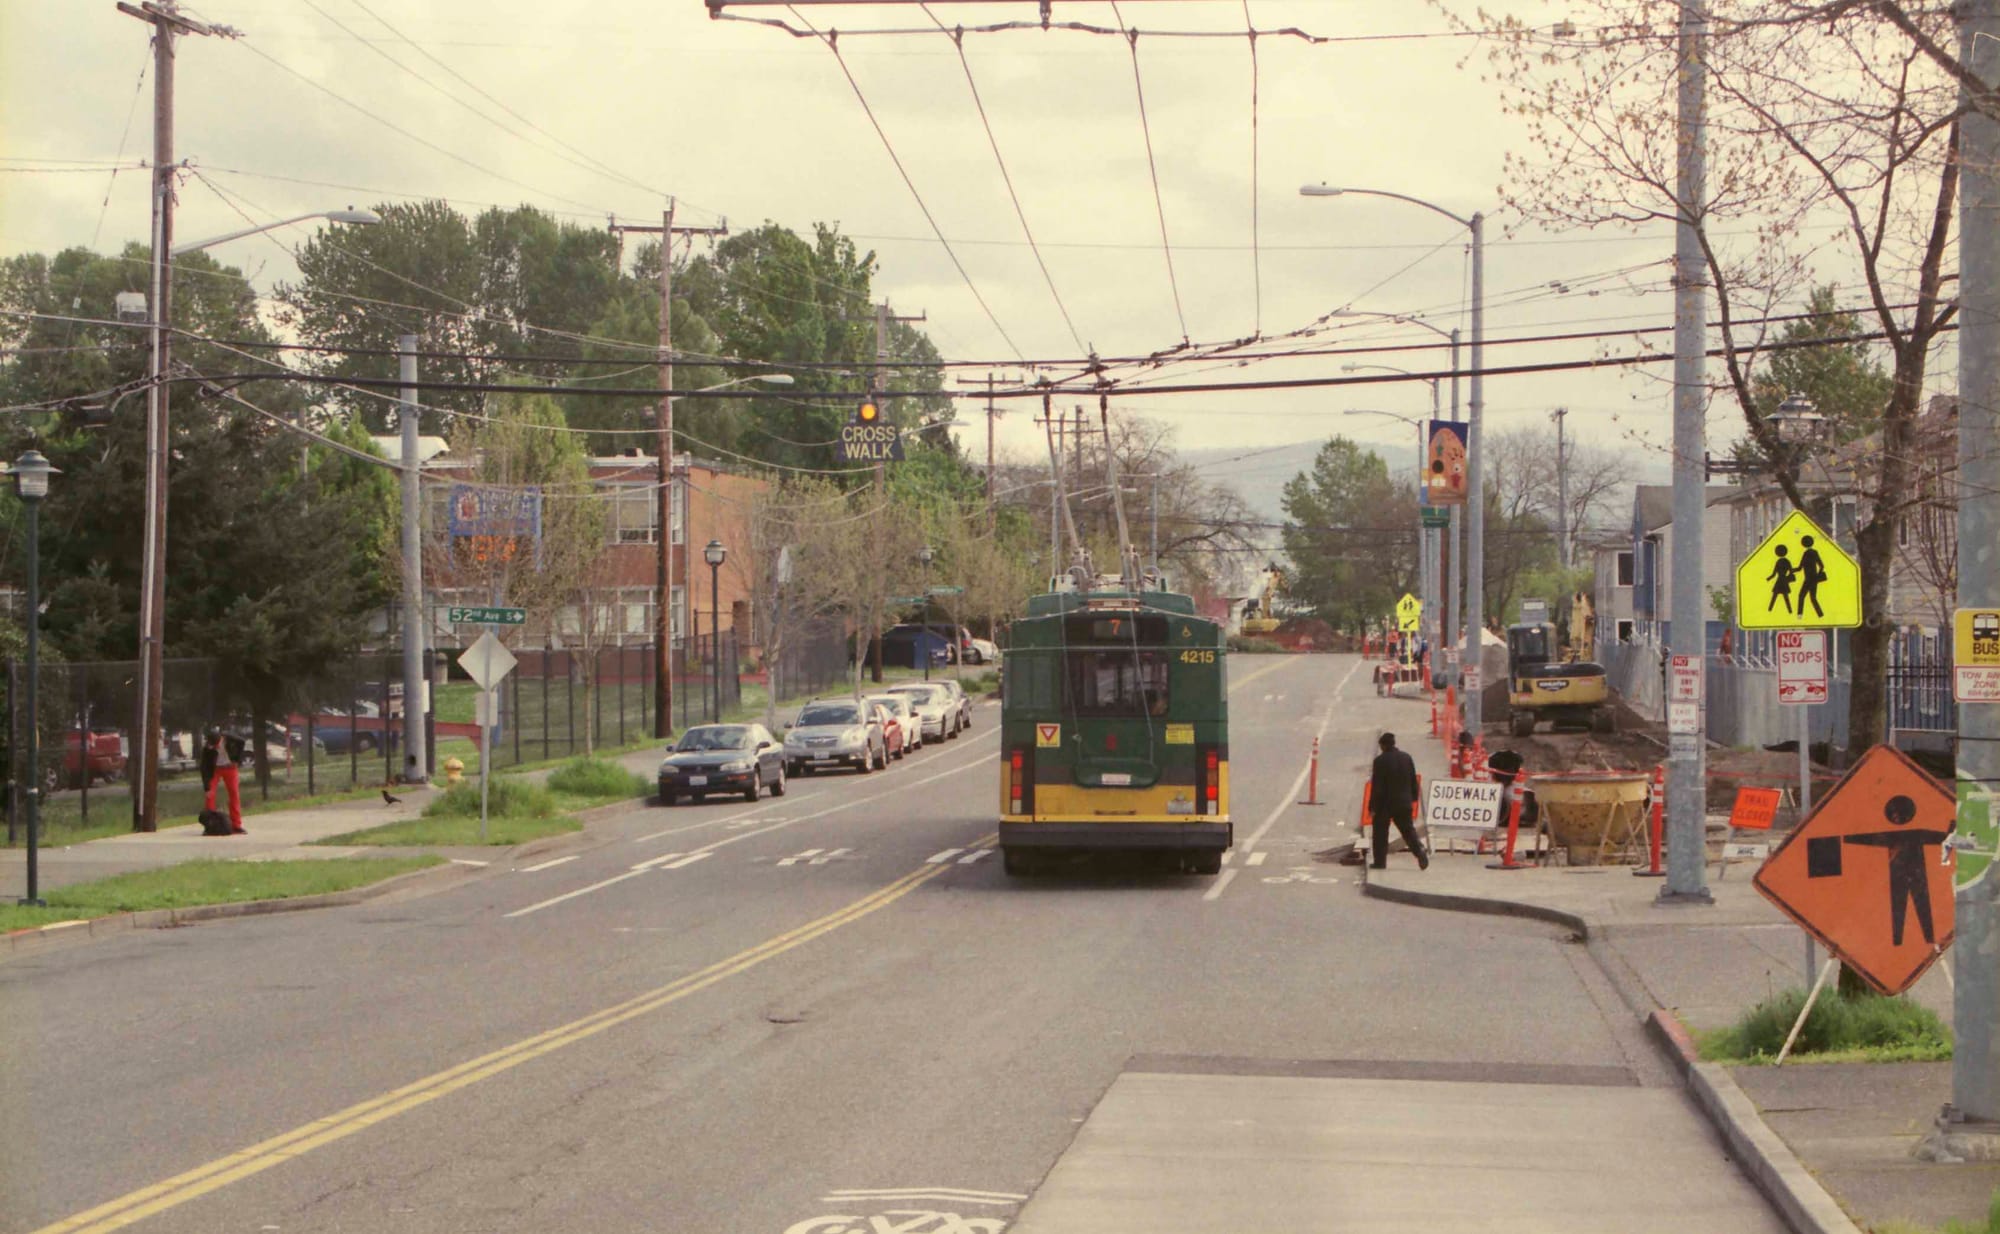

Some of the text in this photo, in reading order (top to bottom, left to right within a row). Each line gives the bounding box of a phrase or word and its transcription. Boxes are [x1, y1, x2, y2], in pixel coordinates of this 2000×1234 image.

[842, 426, 896, 442] CROSS
[845, 442, 893, 459] WALK
[484, 611, 499, 621] Ave
[506, 611, 513, 621] S
[1109, 619, 1121, 635] 7
[1781, 634, 1799, 647] NO
[1973, 642, 1999, 655] BUS
[1180, 651, 1215, 663] 4215
[1674, 657, 1687, 666] NO
[1782, 651, 1822, 663] STOPS
[1962, 671, 1982, 679] TOW
[1973, 681, 1997, 689] ZONE
[1433, 785, 1497, 802] SIDEWALK
[1432, 806, 1492, 822] CLOSED
